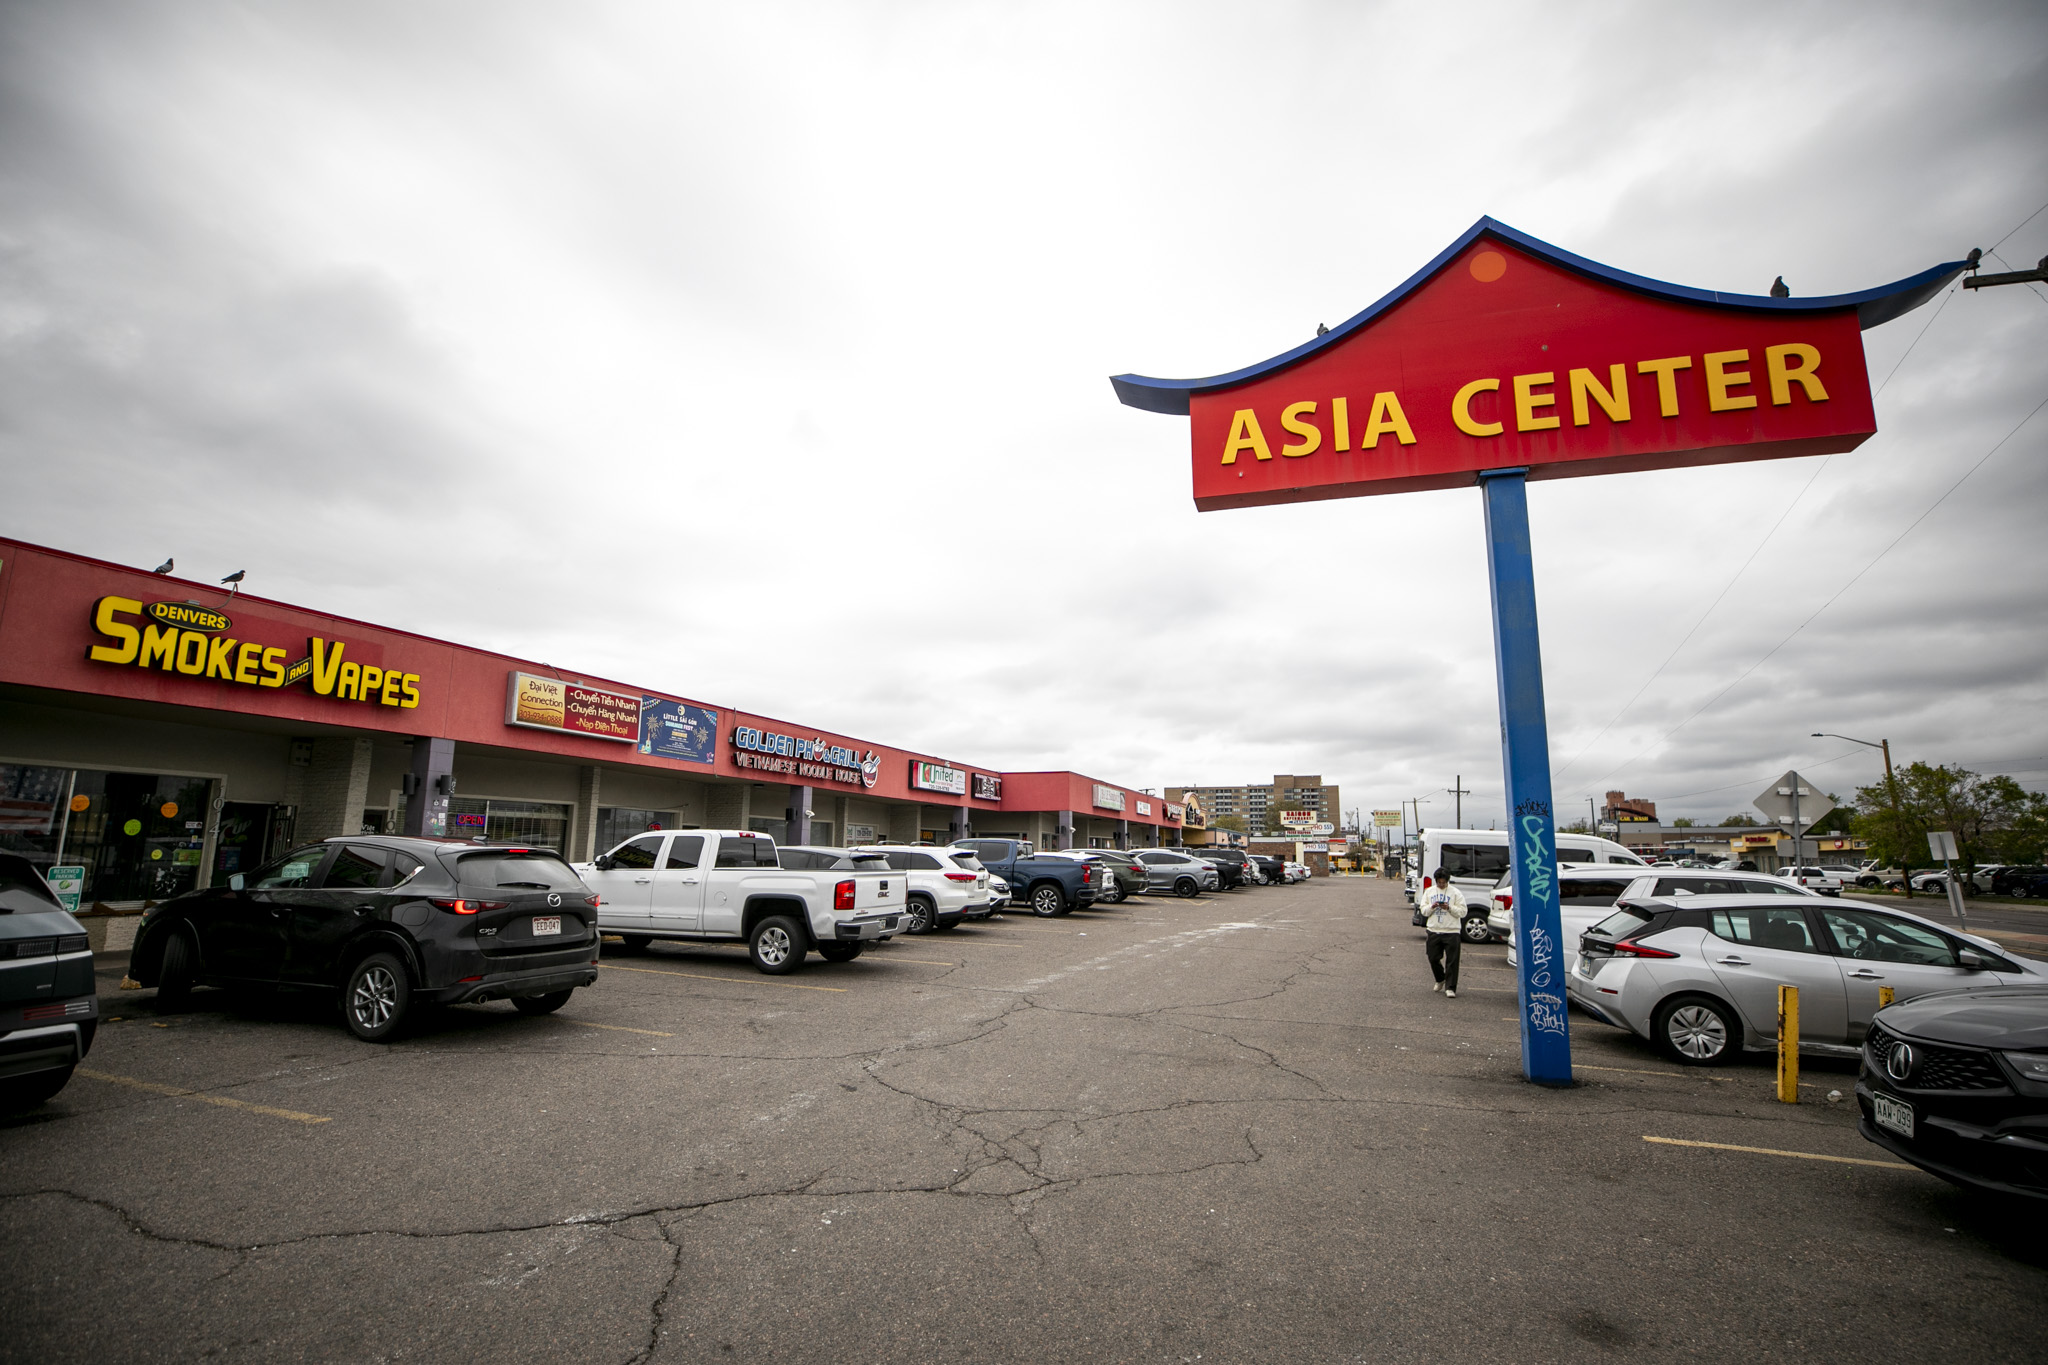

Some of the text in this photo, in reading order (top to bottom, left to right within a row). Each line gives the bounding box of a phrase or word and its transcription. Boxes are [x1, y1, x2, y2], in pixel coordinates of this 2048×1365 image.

[1221, 343, 1829, 466] ASIA CENTER
[154, 603, 228, 630] DENVERS
[88, 595, 421, 709] SMOKES AND VAPES
[543, 683, 558, 696] Việt
[520, 691, 563, 708] Connection
[615, 698, 637, 711] Nhanh
[616, 711, 637, 724] Nhanh
[735, 726, 794, 756] GOLDEN
[830, 746, 862, 769] GRILL
[736, 751, 861, 785] VIETNAMESE NOODLE HOUSE
[930, 764, 954, 784] United
[458, 815, 484, 825] OPEN
[479, 927, 498, 935] CX-5
